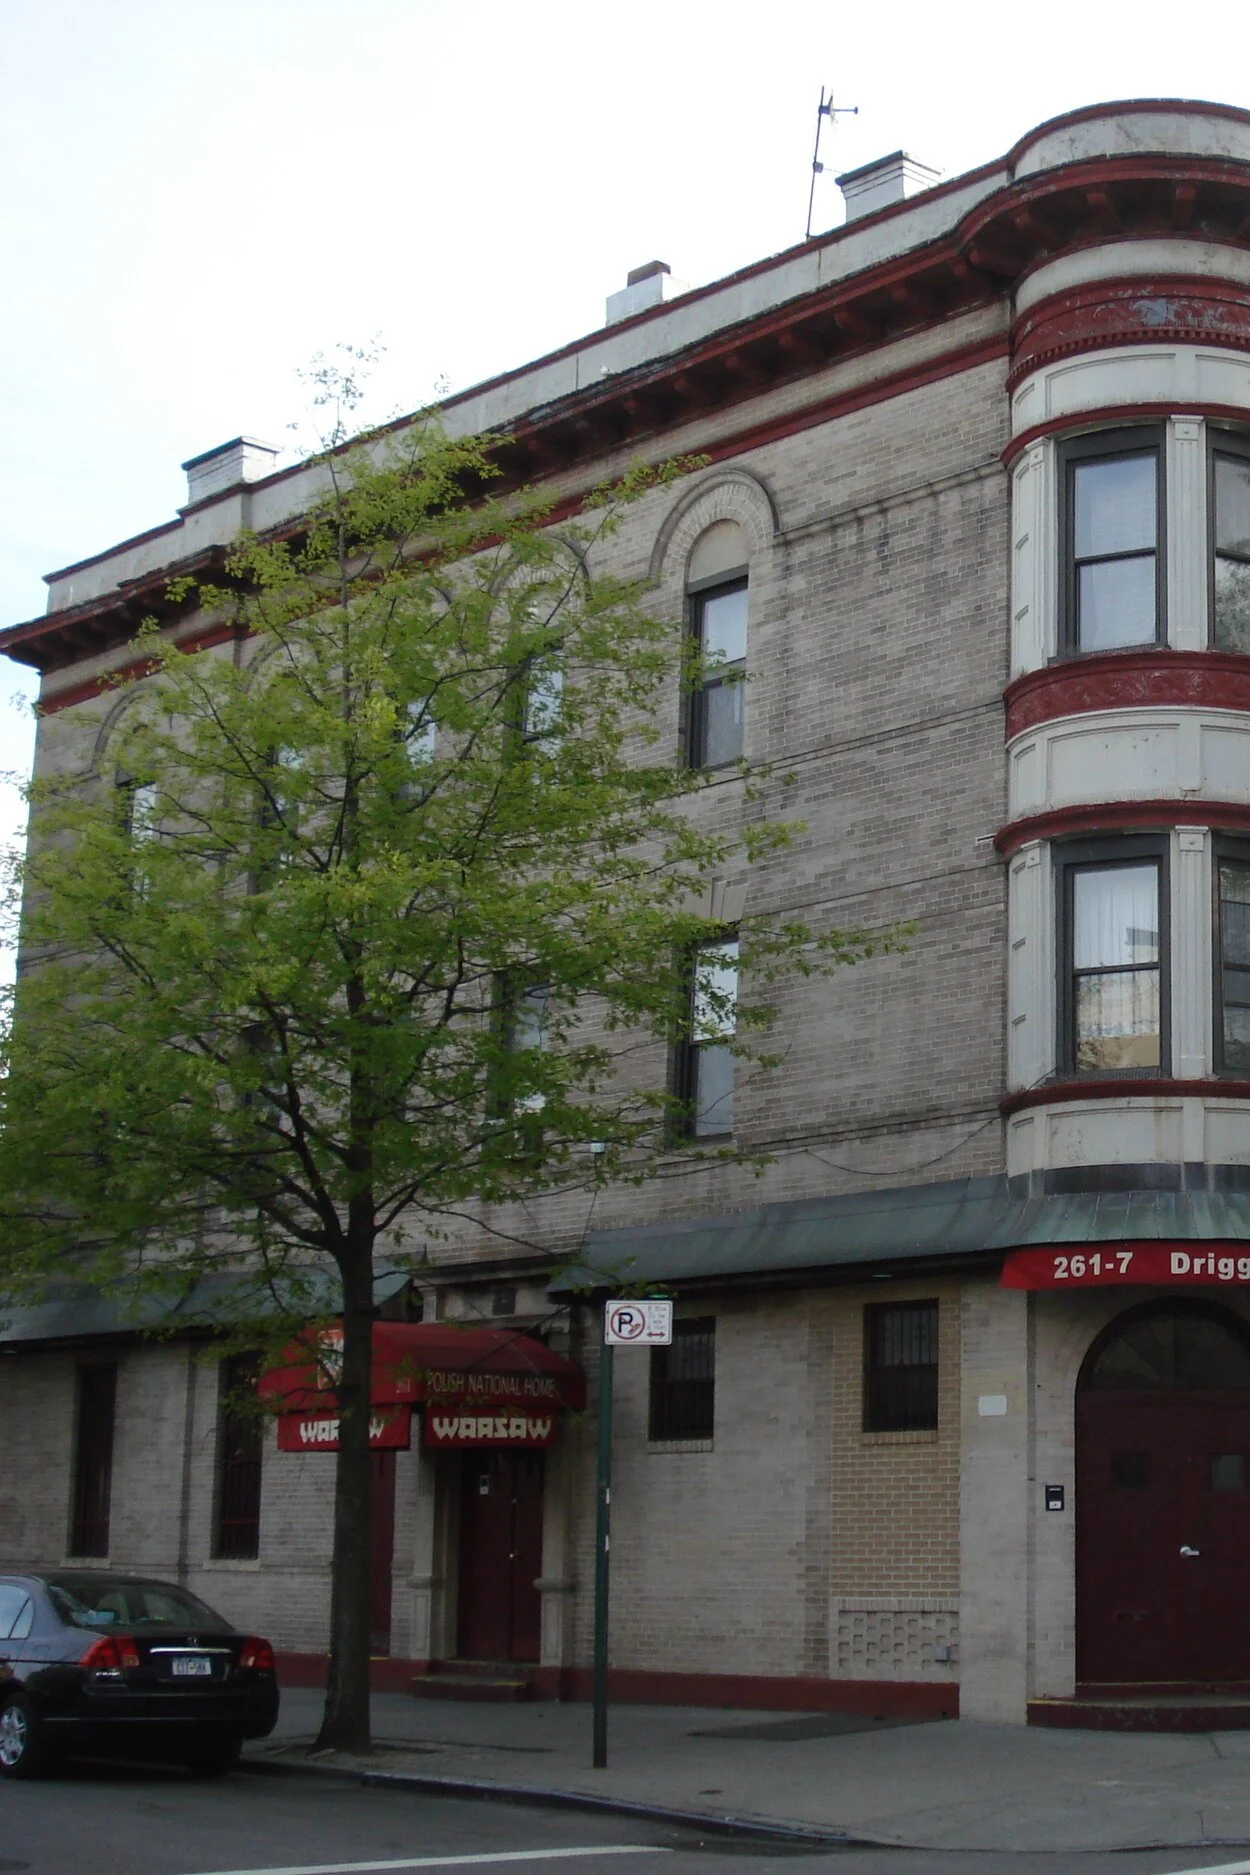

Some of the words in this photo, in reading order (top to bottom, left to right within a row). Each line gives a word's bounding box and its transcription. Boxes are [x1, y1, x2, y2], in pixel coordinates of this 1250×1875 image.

[1053, 1252, 1133, 1279] 261-7
[427, 1371, 464, 1393] POLISH
[468, 1374, 522, 1396] NATIONAL
[524, 1377, 556, 1398] HOME
[432, 1417, 552, 1440] WARSAW
